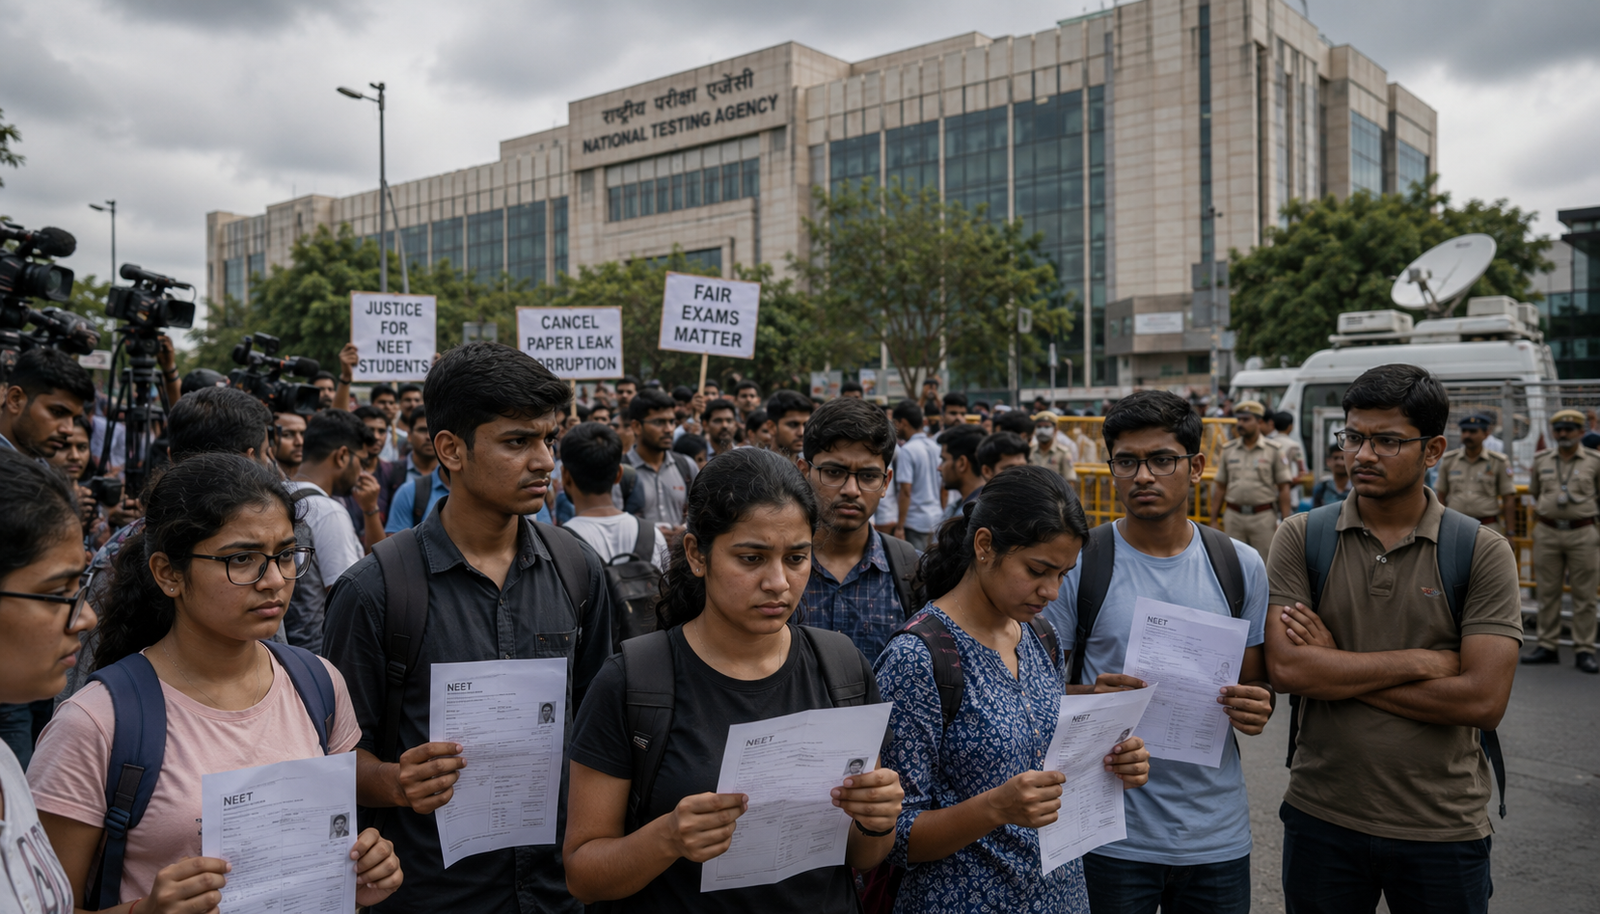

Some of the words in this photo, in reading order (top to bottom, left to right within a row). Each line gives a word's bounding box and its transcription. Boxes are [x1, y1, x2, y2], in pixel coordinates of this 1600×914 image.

[602, 99, 646, 125] राष्ट्रीय
[653, 87, 697, 111] परीक्षा
[583, 126, 648, 154] NATIONAL
[650, 111, 711, 138] TESTING
[714, 94, 779, 124] AGENCY
[694, 284, 732, 303] FAIR
[365, 301, 422, 317] JUSTICE
[682, 305, 739, 326] EXAMS
[381, 321, 408, 335] FOR
[541, 315, 599, 330] CANCEL
[527, 336, 573, 350] PAPER
[578, 335, 614, 349] LEAK
[674, 326, 742, 348] MATTER
[376, 339, 412, 354] NEET
[359, 358, 429, 373] STUDENTS
[537, 356, 616, 371] RRUPTION
[447, 682, 472, 692] NEET
[745, 735, 775, 747] NEET
[223, 791, 253, 806] NEET
